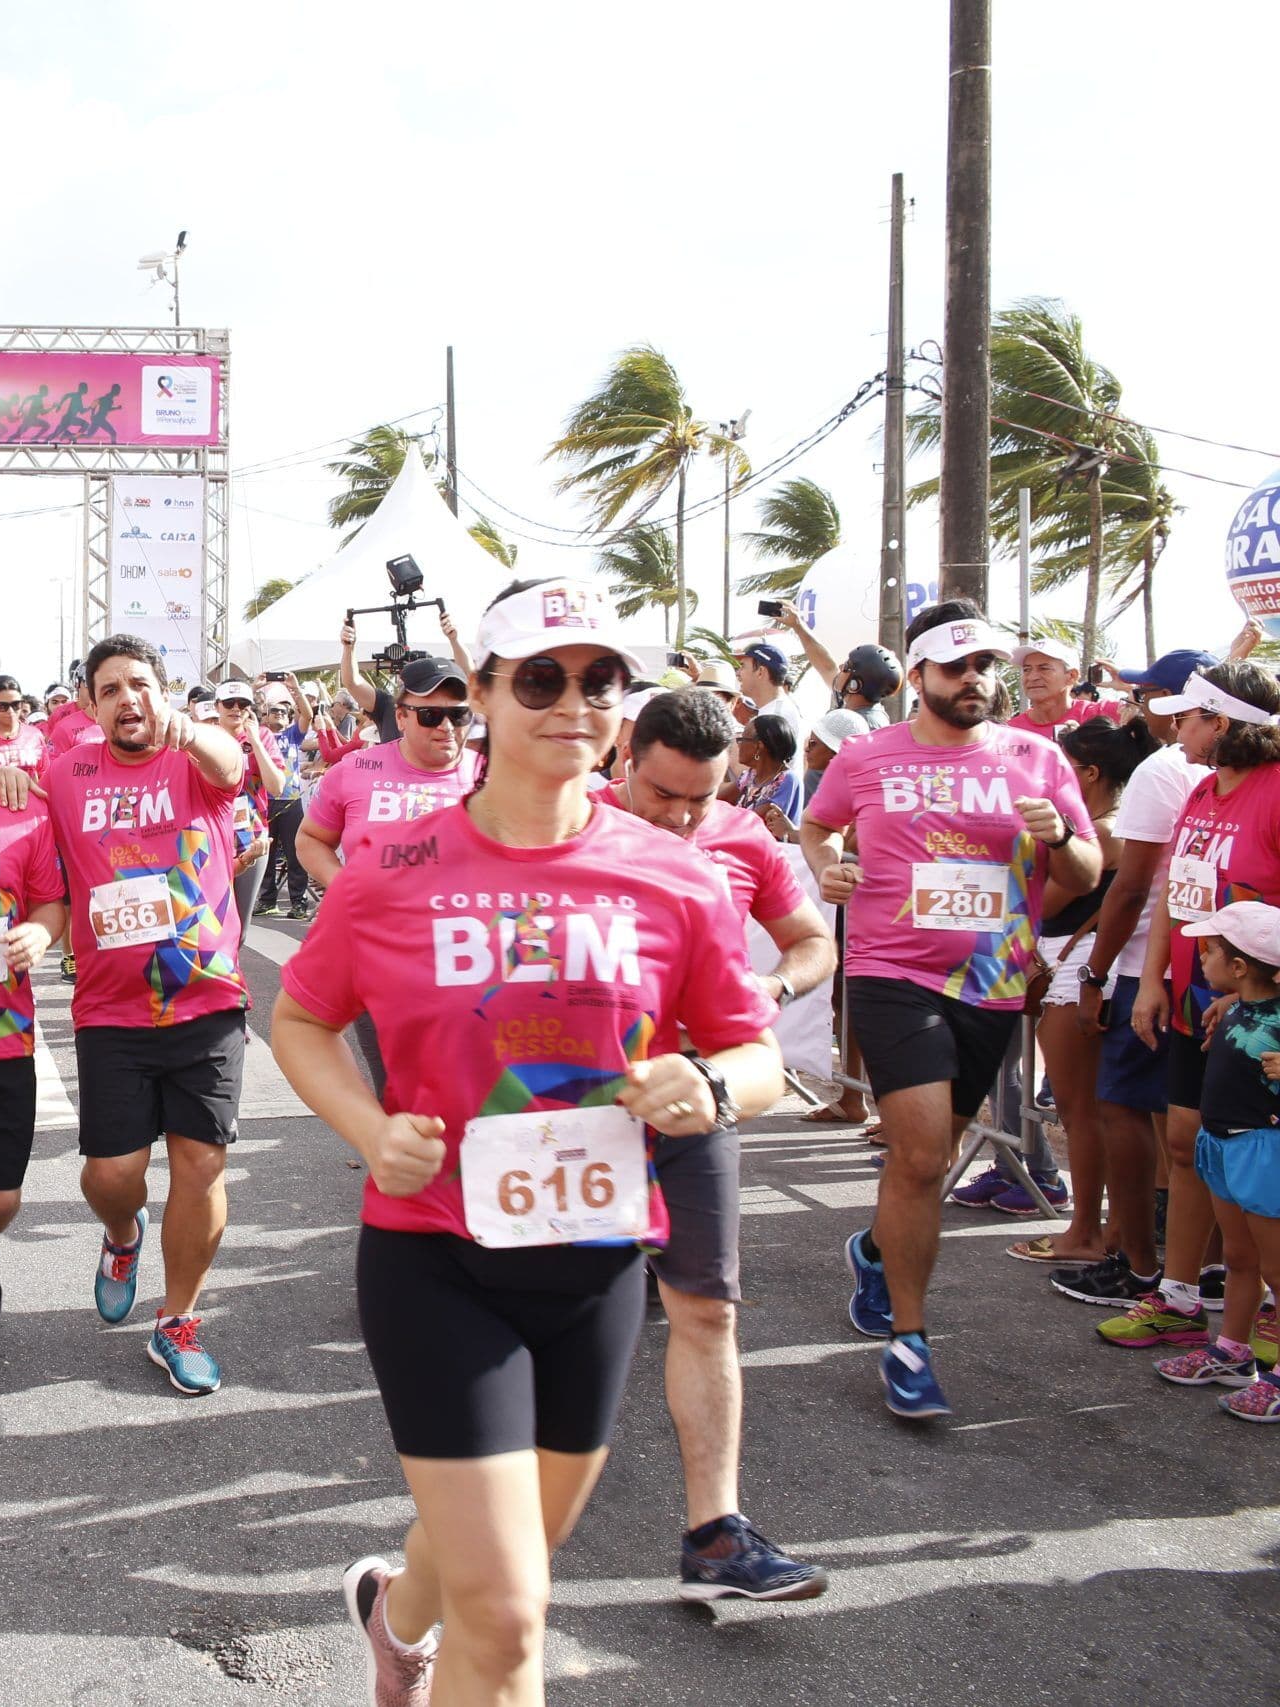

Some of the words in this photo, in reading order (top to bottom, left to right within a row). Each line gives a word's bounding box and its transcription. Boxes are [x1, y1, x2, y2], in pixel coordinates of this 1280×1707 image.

[174, 498, 194, 507] hnsn
[160, 532, 196, 541] CAIXA
[879, 764, 969, 775] CORRIDA
[982, 766, 1008, 774] DO
[880, 776, 1014, 815] BEM
[82, 786, 176, 832] BEM
[924, 841, 990, 856] PESSOA
[926, 830, 967, 844] JOÃO
[110, 854, 160, 868] PESSOA
[429, 892, 577, 911] CORRIDA
[594, 894, 638, 910] DO
[928, 890, 993, 918] 280
[1168, 881, 1202, 909] 240
[102, 903, 158, 934] 566
[432, 914, 642, 988] BEM
[496, 1014, 562, 1038] JOÃO
[492, 1036, 596, 1061] PESSOA
[498, 1162, 616, 1217] 616
